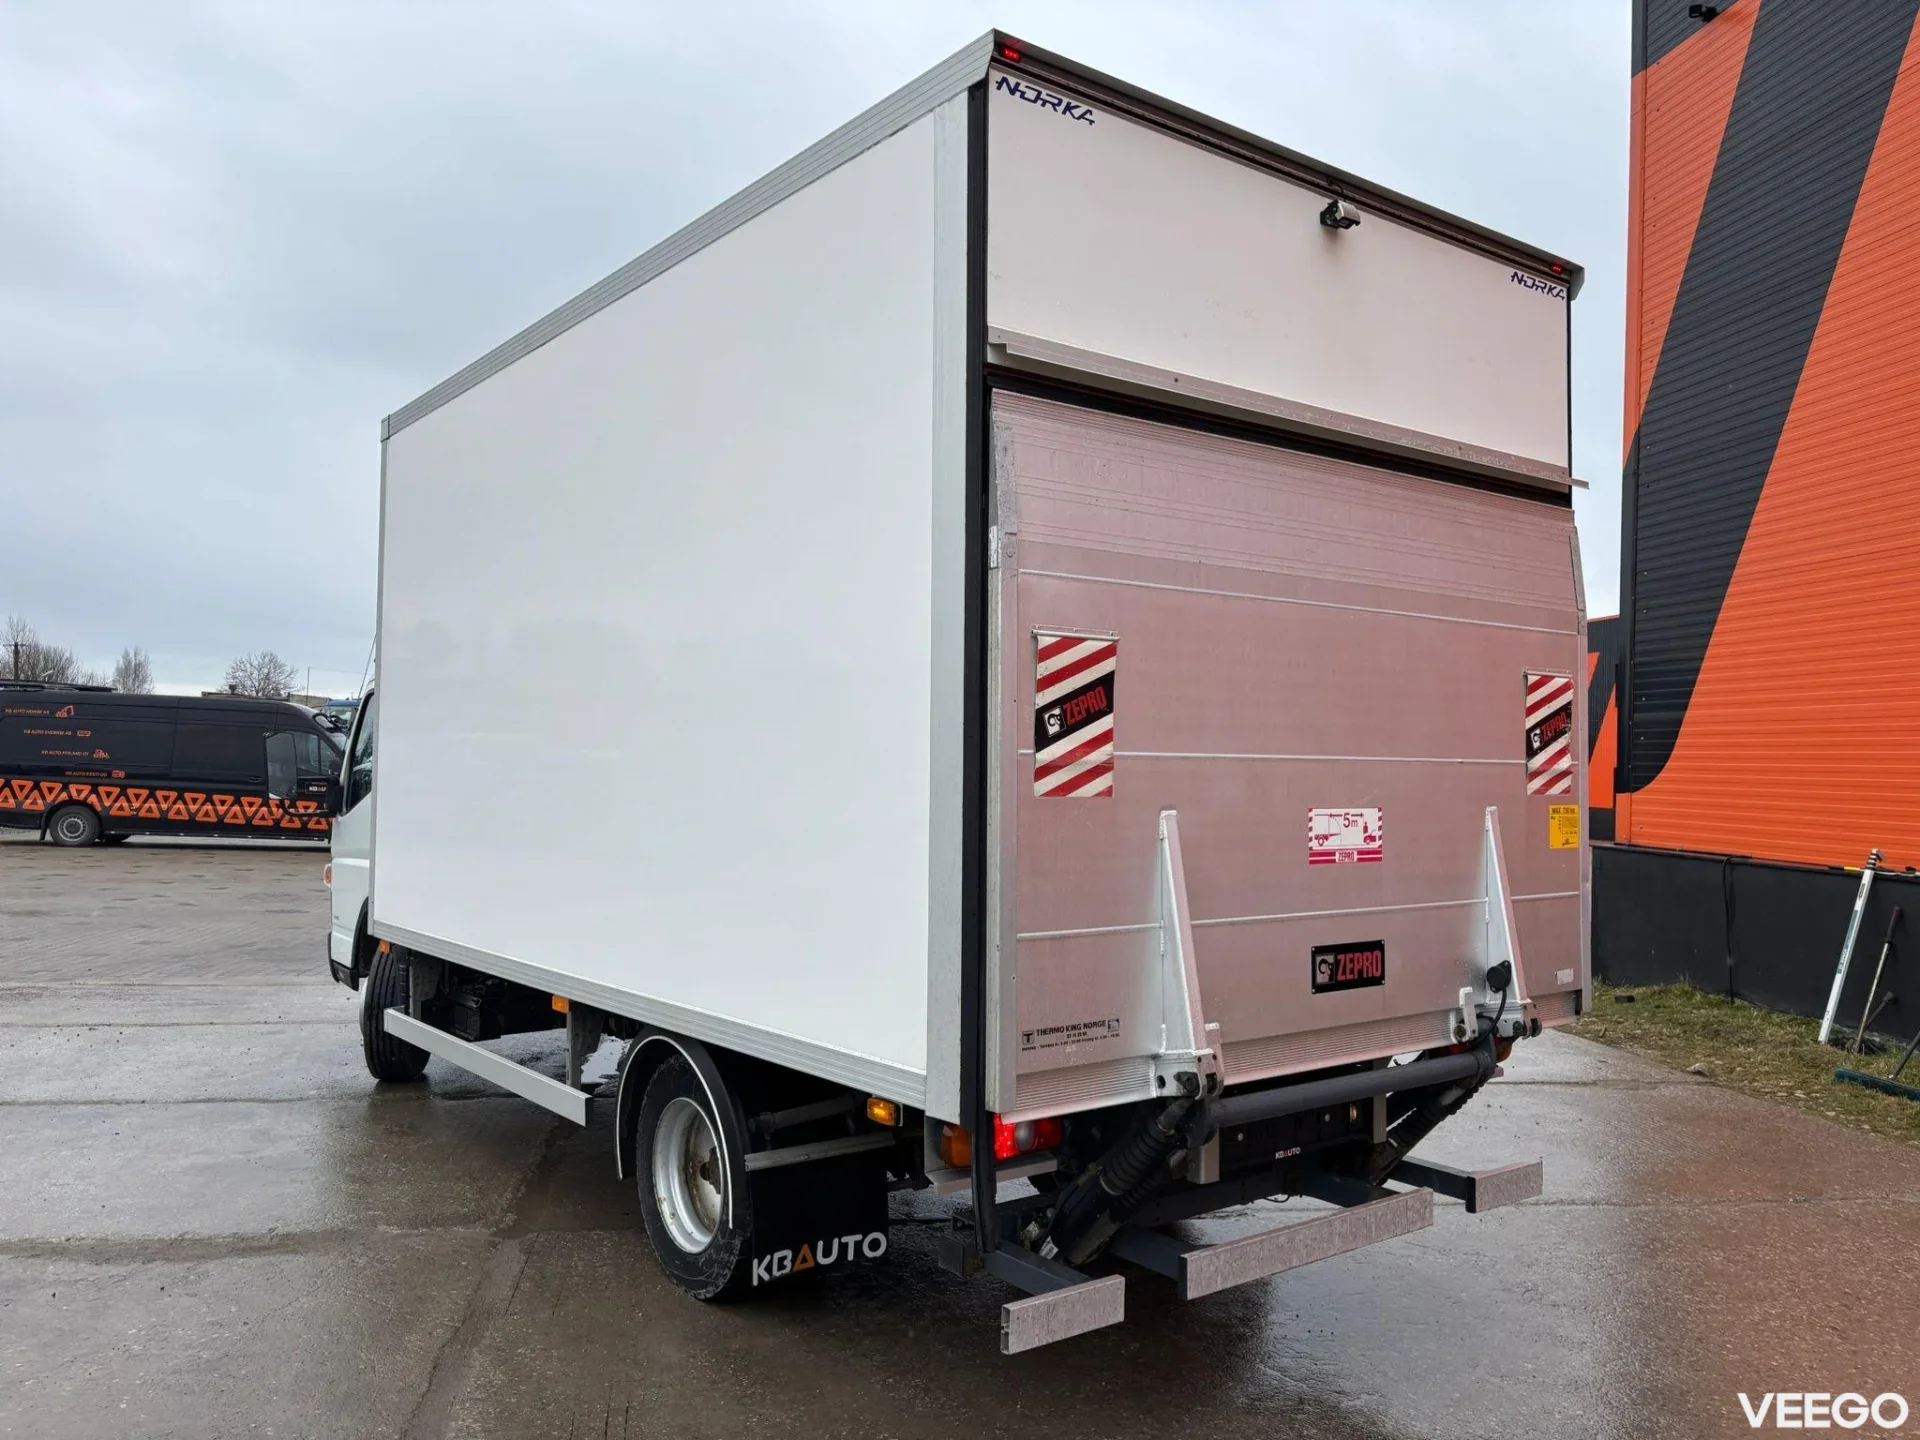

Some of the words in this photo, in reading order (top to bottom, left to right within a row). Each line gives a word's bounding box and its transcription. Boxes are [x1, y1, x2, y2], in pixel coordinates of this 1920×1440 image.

[995, 76, 1095, 126] NORKA
[1510, 271, 1566, 301] NORKA
[1063, 686, 1108, 725] ZEPRO
[1541, 712, 1568, 742] ZEPRO
[1337, 851, 1355, 862] ZEPRO
[1336, 950, 1382, 981] ZEPRO
[1036, 1026, 1065, 1037] THERMO
[1065, 1023, 1082, 1032] KING
[1083, 1019, 1106, 1030] NORGE
[1275, 1147, 1301, 1159] KBAUTO
[752, 1231, 887, 1287] KBAUTO
